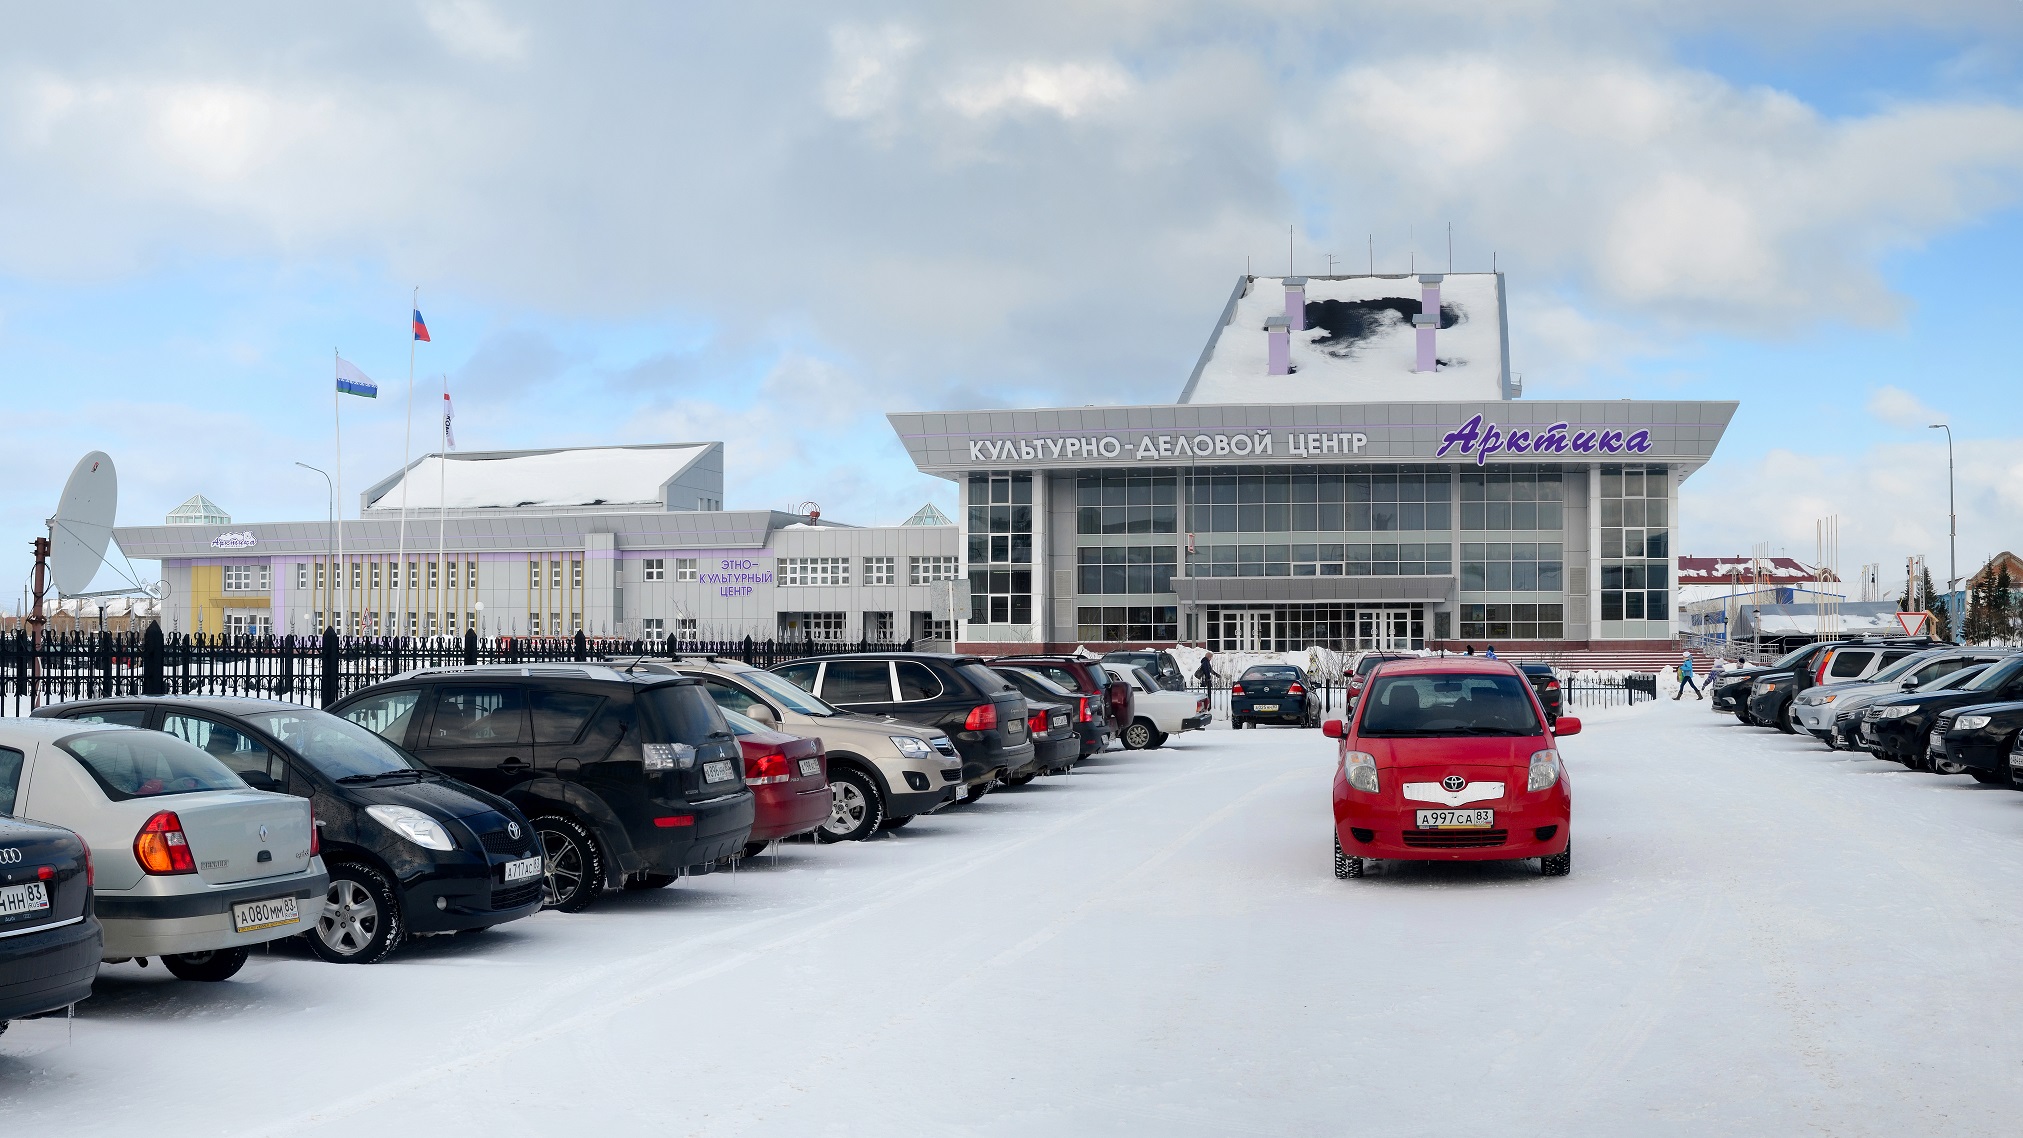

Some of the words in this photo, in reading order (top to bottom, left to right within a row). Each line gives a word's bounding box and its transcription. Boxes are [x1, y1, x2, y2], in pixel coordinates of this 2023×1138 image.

[969, 429, 1273, 461] КУЛЬТУРНО-ДЕЛОВОЙ
[1288, 432, 1368, 458] ЦЕНТР
[1436, 412, 1653, 467] Арктика
[721, 559, 759, 570] ЭТНО-
[699, 570, 773, 584] КУЛЬТУРНЫЙ
[720, 586, 753, 598] ЦЕНТР
[1475, 811, 1489, 821] 83
[27, 884, 42, 902] 83
[284, 899, 294, 913] 83
